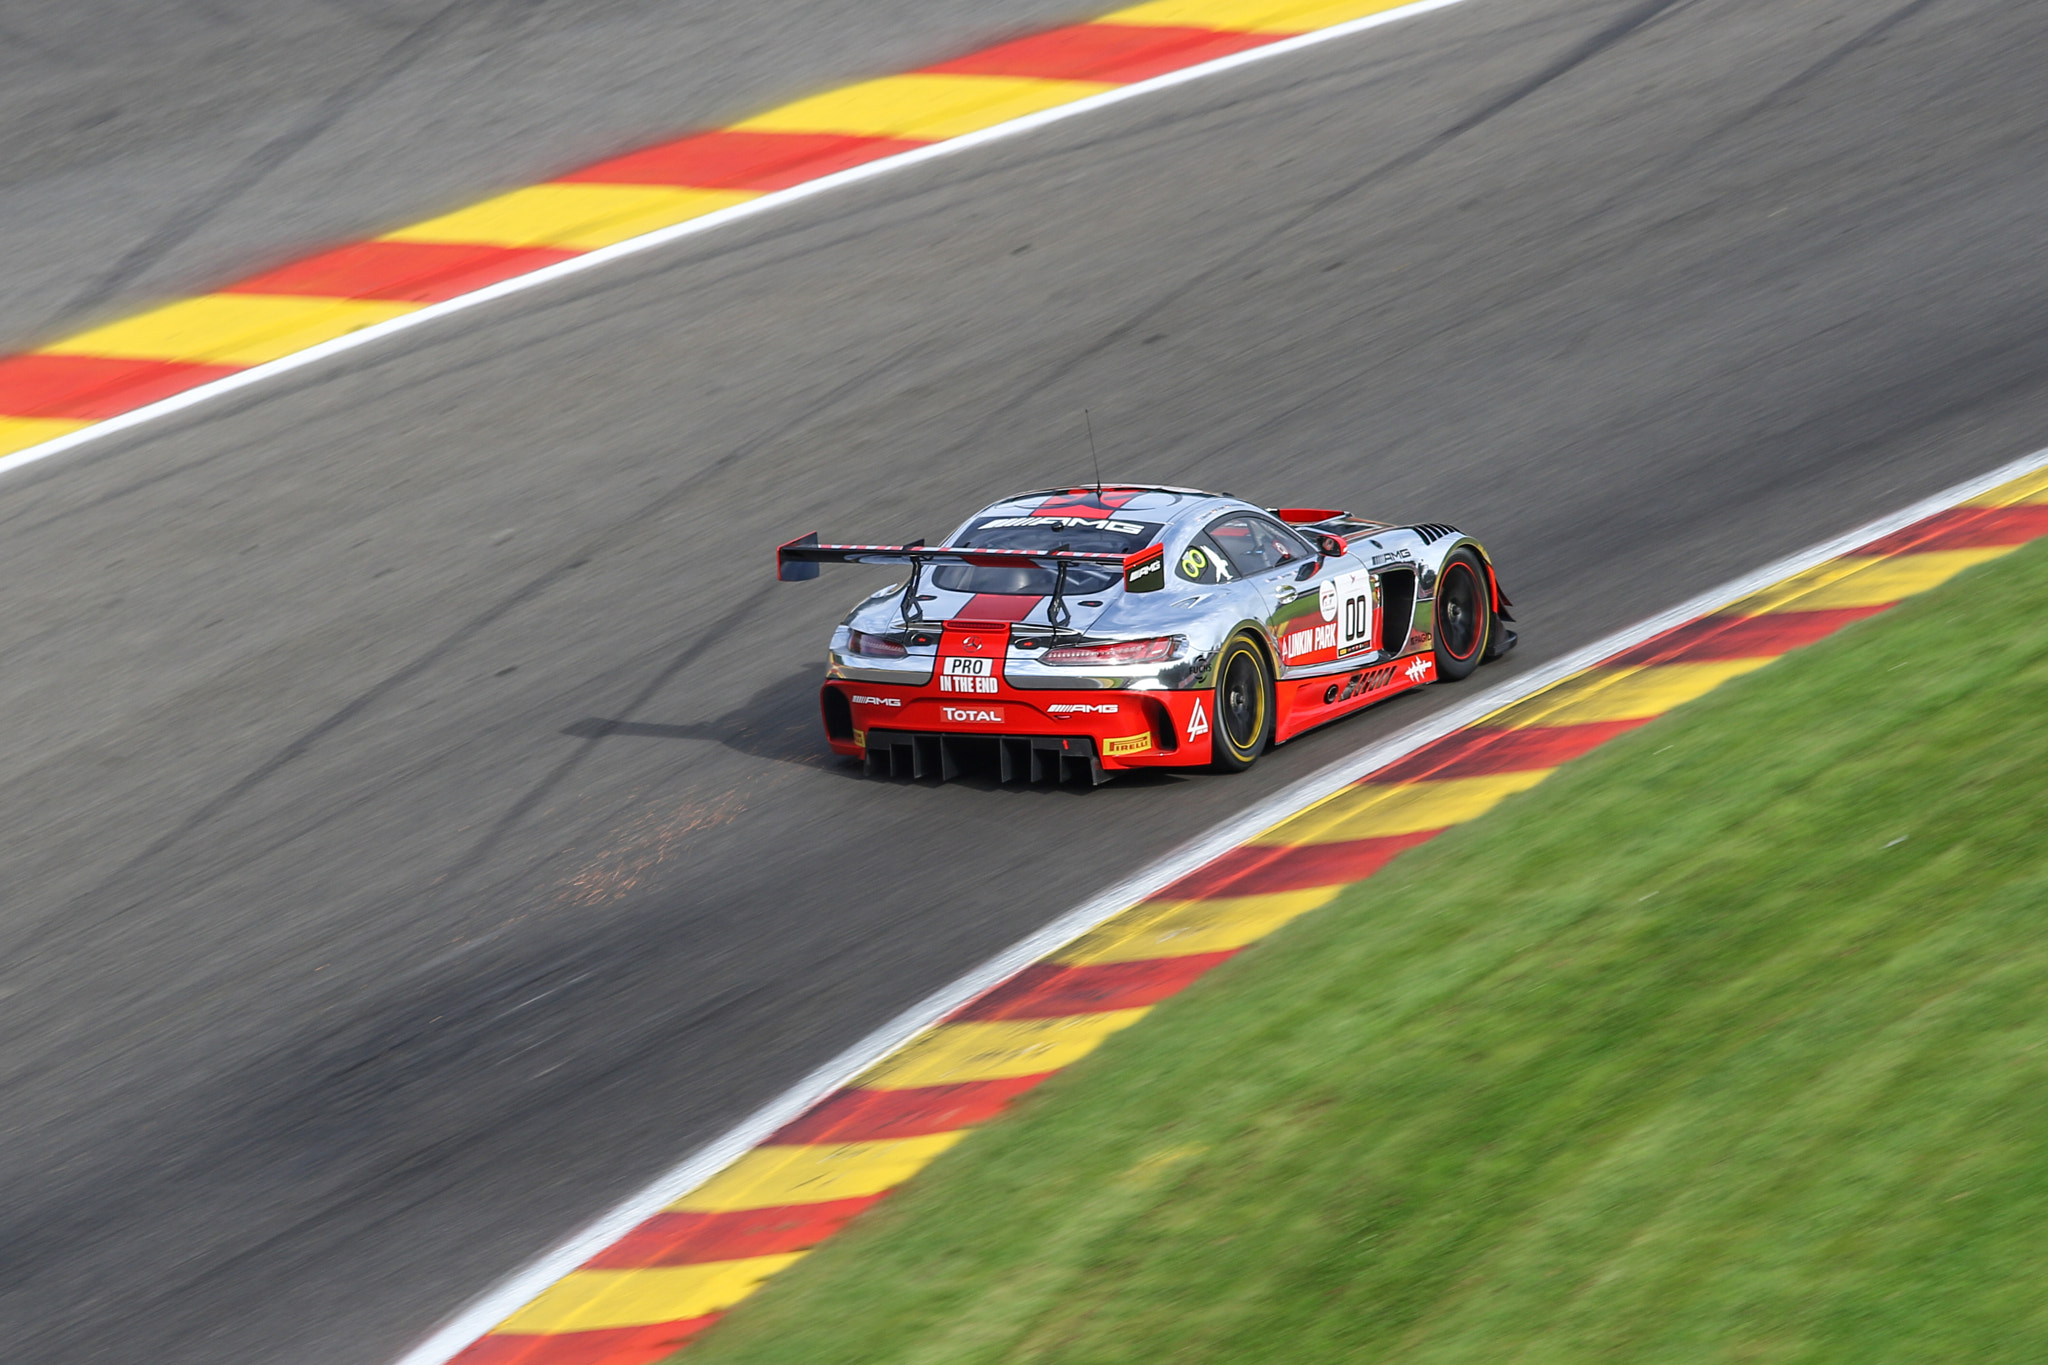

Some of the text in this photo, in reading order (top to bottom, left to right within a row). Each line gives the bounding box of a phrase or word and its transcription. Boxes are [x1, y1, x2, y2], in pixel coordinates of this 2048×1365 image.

[1028, 517, 1145, 535] AMG
[1383, 548, 1412, 563] AMG
[1346, 594, 1366, 642] 00
[1288, 628, 1313, 659] LINKIN
[1314, 622, 1337, 651] PARK
[951, 658, 984, 675] PRO
[1189, 663, 1212, 675] FUCHS
[940, 675, 999, 694] IN THE END
[864, 696, 902, 707] AMG
[1070, 704, 1119, 714] AMG
[1109, 735, 1148, 752] PIRELLI
